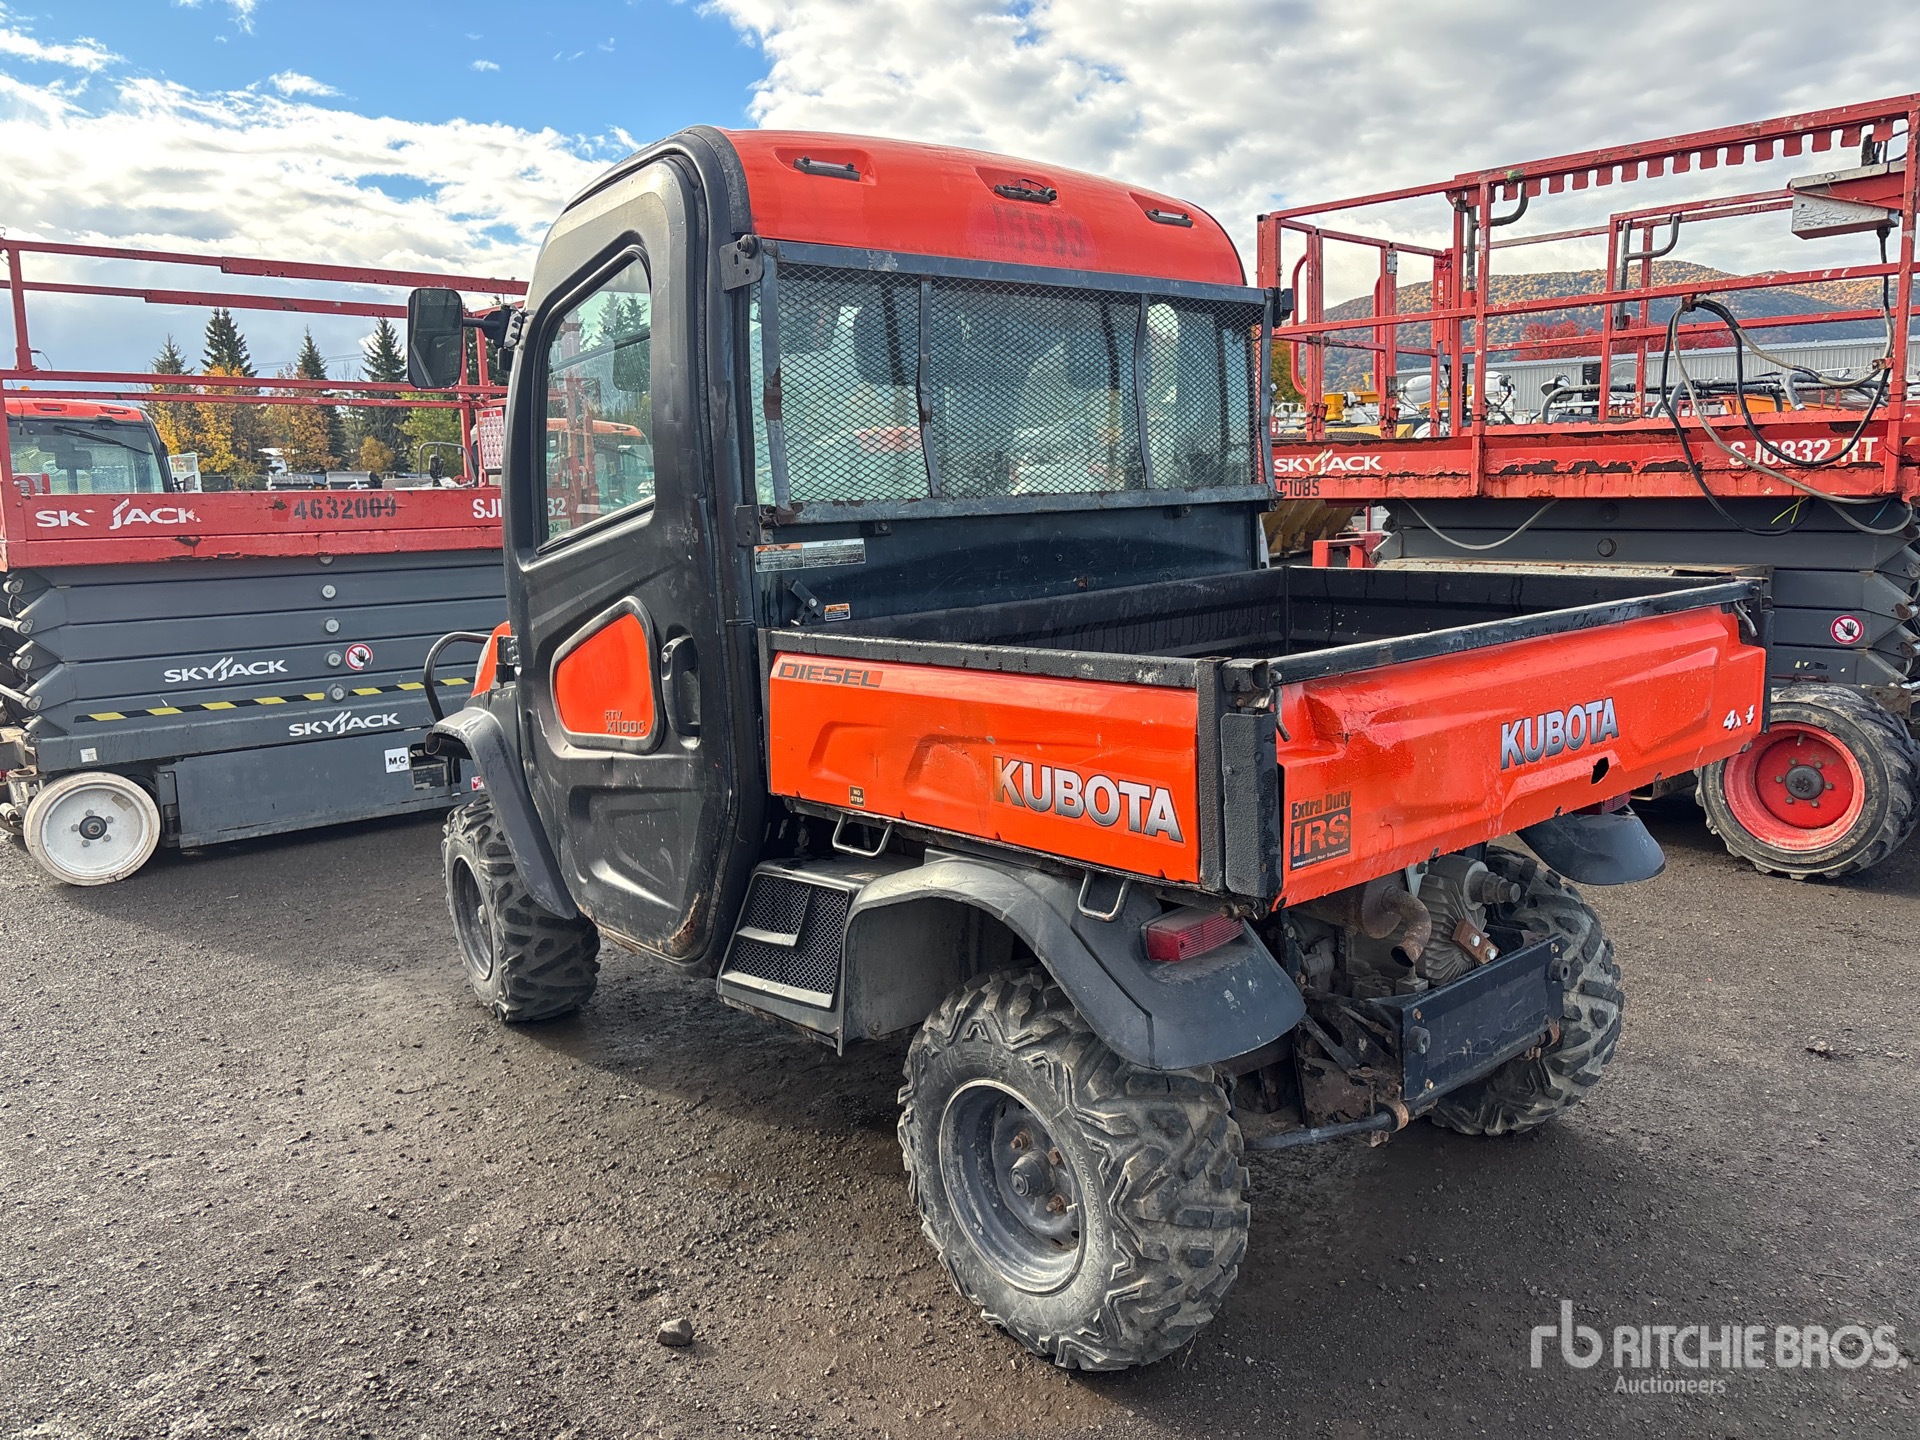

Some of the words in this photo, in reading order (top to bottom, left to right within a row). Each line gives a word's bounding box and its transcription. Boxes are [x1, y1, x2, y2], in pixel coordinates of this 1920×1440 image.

[1273, 448, 1383, 475] SKYJACK
[1841, 437, 1879, 463] RT
[35, 498, 202, 530] SKJACK
[294, 496, 397, 520] 4632009
[164, 657, 289, 683] SKYJACK
[778, 662, 881, 688] DIESEL
[289, 711, 401, 737] SKYJACK
[1501, 696, 1619, 770] KUBOTA
[388, 755, 407, 766] MC
[850, 795, 864, 803] STEP
[993, 755, 1185, 843] KUBOTA
[1291, 800, 1323, 821] Extra
[1325, 790, 1352, 812] Duty
[1293, 813, 1350, 858] IRS
